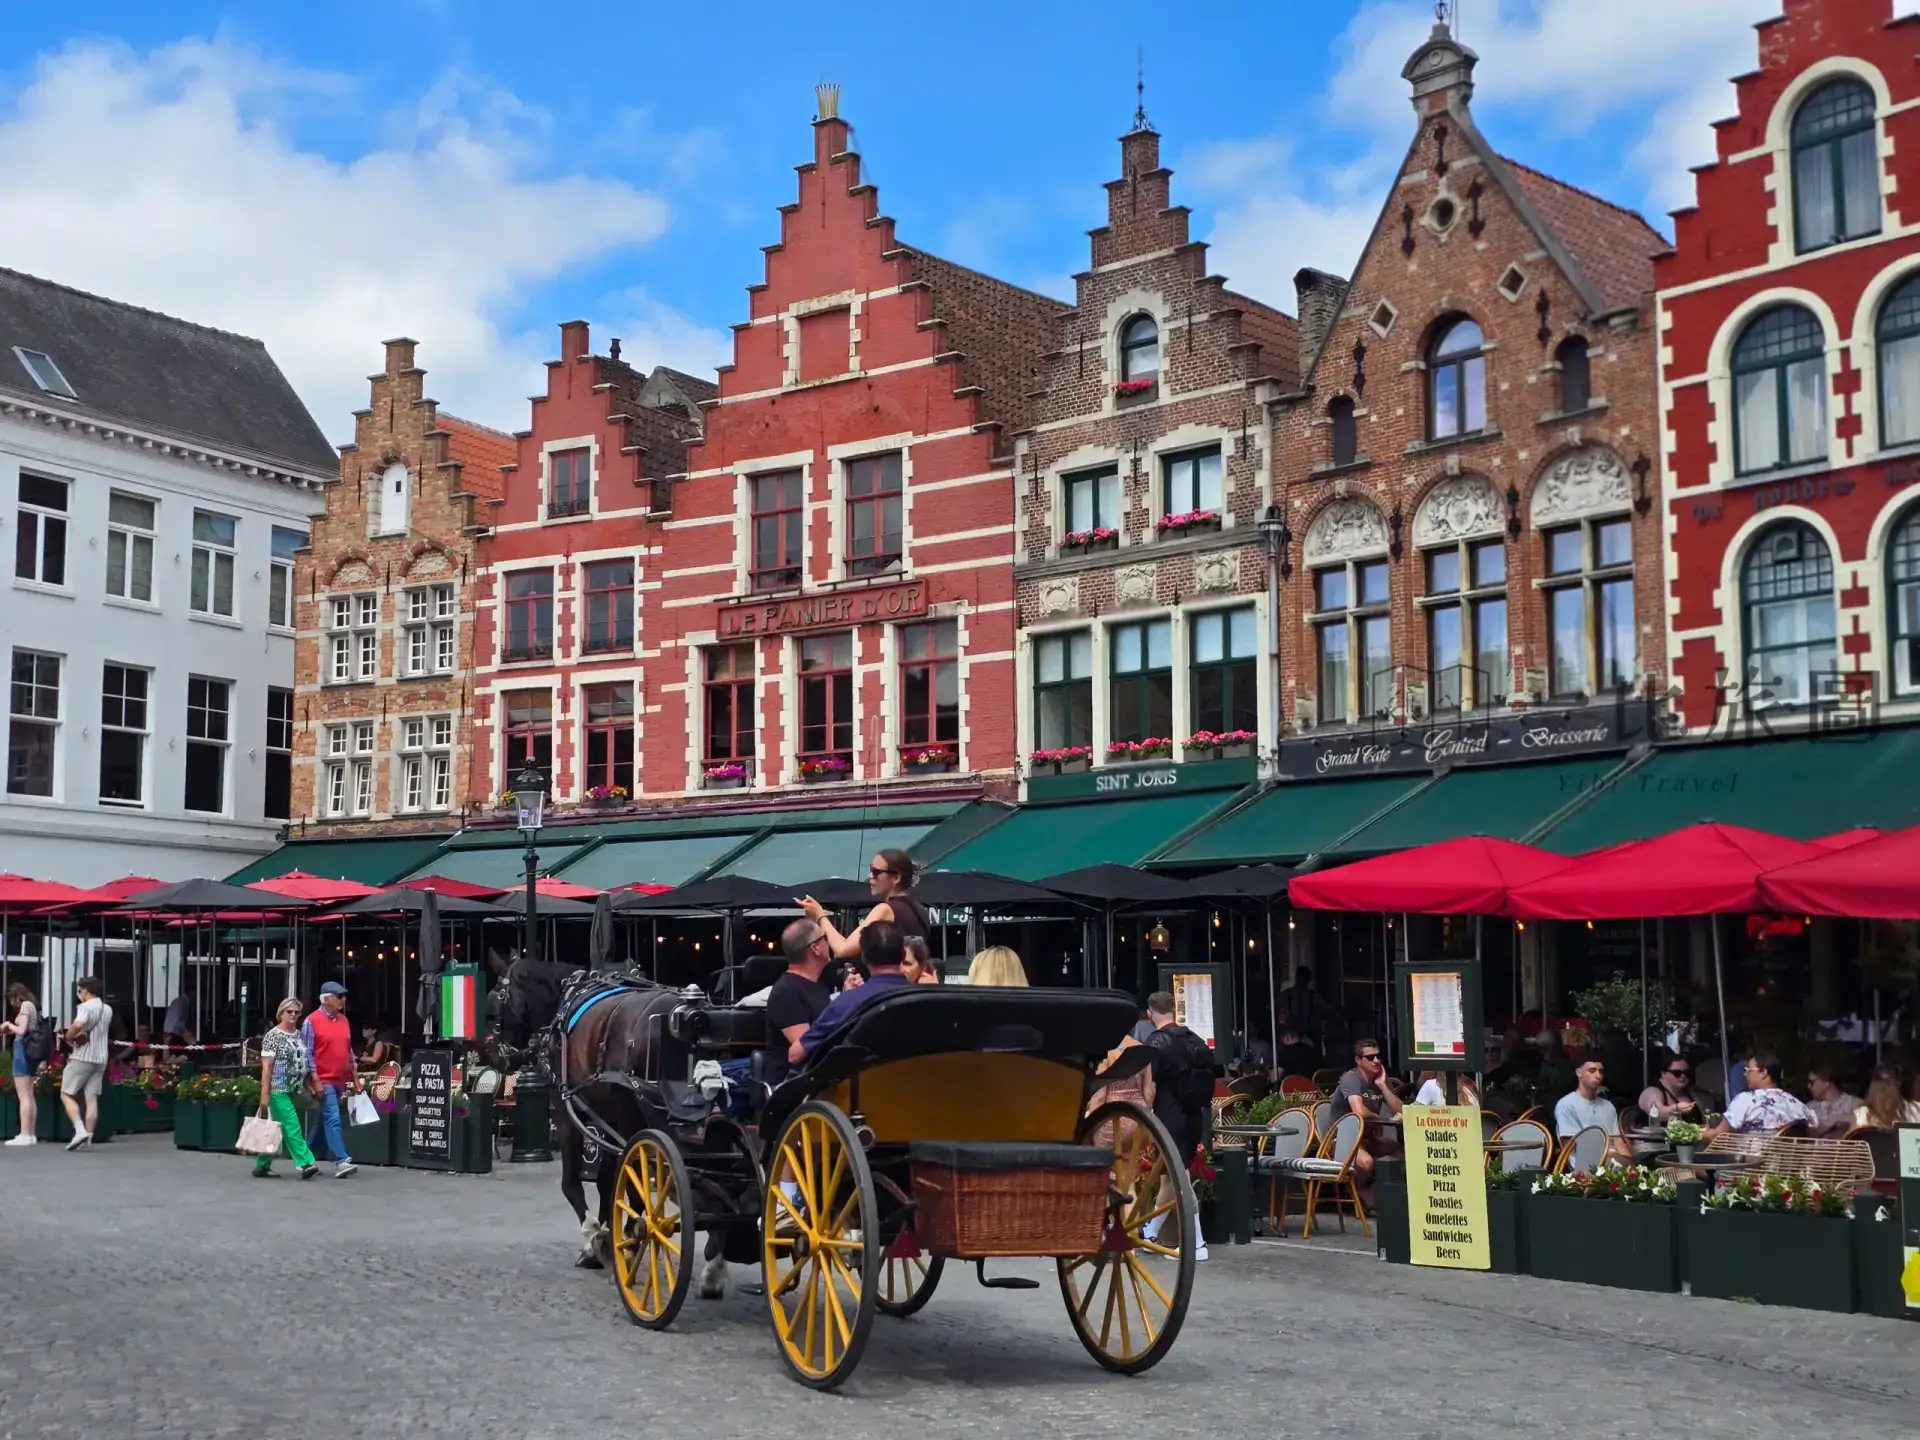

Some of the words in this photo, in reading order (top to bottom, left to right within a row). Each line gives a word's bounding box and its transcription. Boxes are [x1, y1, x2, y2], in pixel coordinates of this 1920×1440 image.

[726, 613, 756, 635] LE
[761, 595, 853, 631] PANIER
[861, 588, 920, 618] D'OR
[1316, 747, 1360, 774] Grand
[1424, 729, 1488, 763] Central
[1521, 722, 1608, 748] Brasserie
[1096, 773, 1129, 792] SINT
[1134, 769, 1176, 788] JORIS
[421, 1064, 440, 1075] PIZZA
[417, 1078, 423, 1089] &
[425, 1078, 444, 1090] PASTA
[416, 1095, 426, 1103] SOUP
[428, 1096, 444, 1104] SALADS
[418, 1107, 441, 1116] BAGUETTES
[1416, 1116, 1425, 1126] La
[1453, 1117, 1468, 1127] d'or
[412, 1131, 423, 1139] MILK
[1424, 1130, 1457, 1142] Salades
[430, 1140, 447, 1148] WAFFLES
[1427, 1147, 1458, 1159] Pasta's
[1426, 1163, 1461, 1177] Burgers
[1433, 1179, 1456, 1192] Pizza
[1428, 1196, 1463, 1209] Toasties
[1425, 1212, 1468, 1226] Omelettes
[1423, 1229, 1473, 1243] Sandwiches
[1436, 1246, 1461, 1259] Beers
